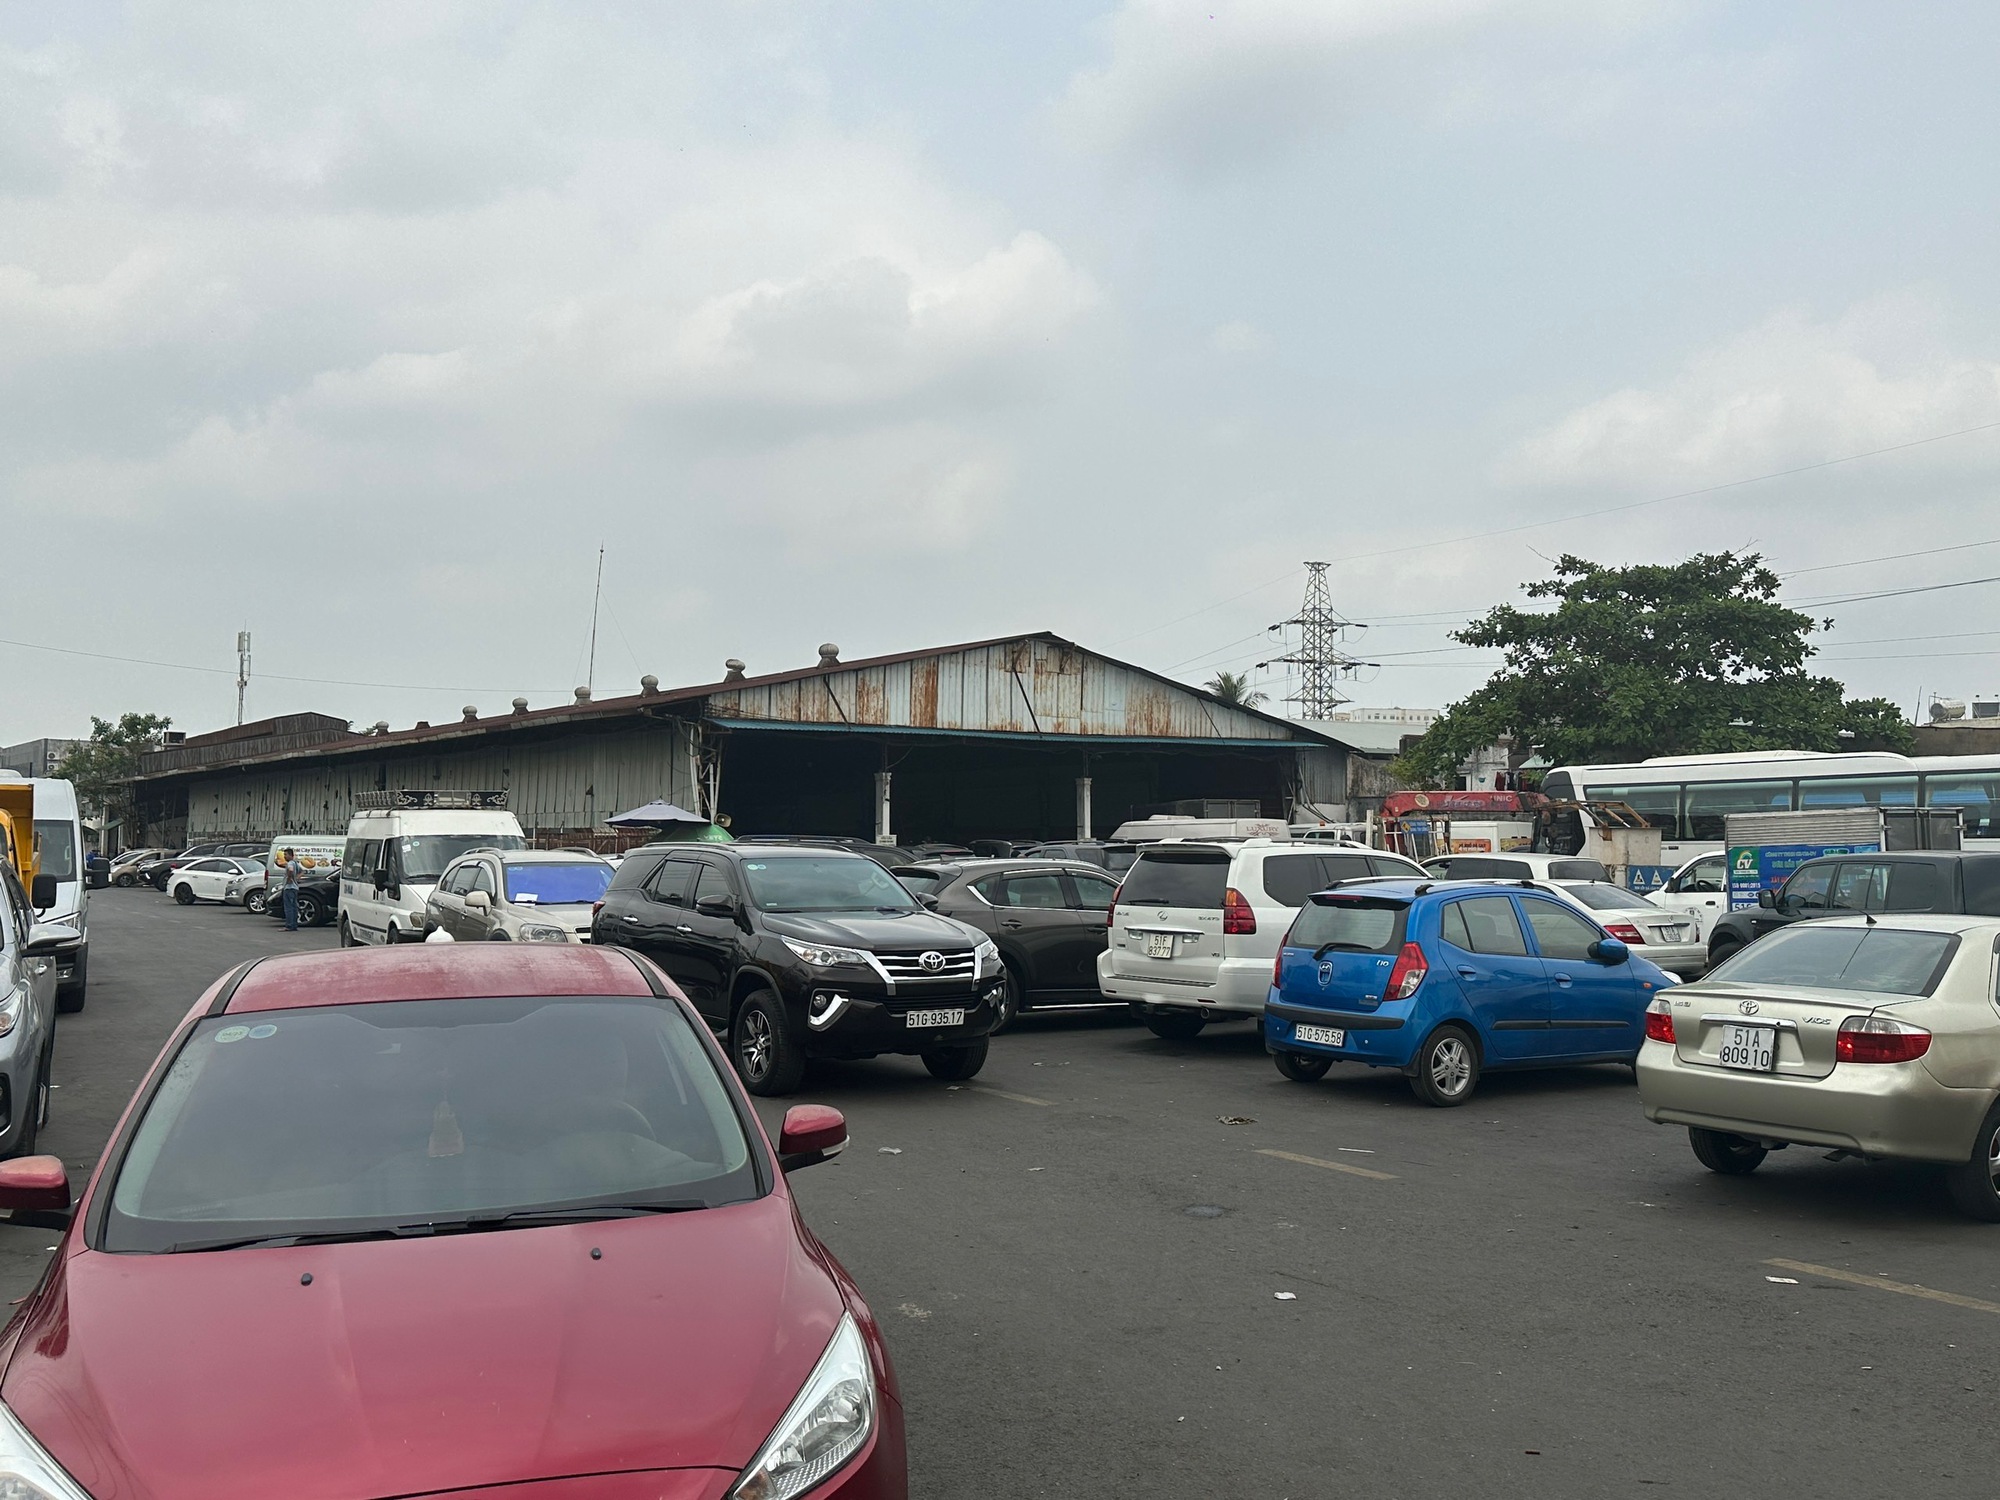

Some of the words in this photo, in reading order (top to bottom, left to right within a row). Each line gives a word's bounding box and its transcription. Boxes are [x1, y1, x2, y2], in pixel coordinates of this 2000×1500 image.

[1736, 859, 1753, 869] CV
[1154, 935, 1168, 946] 51F
[908, 1011, 963, 1027] 51G-935.17
[1802, 1016, 1832, 1026] VIOS
[1734, 1028, 1760, 1048] 51A
[1722, 1046, 1770, 1067] 809.10
